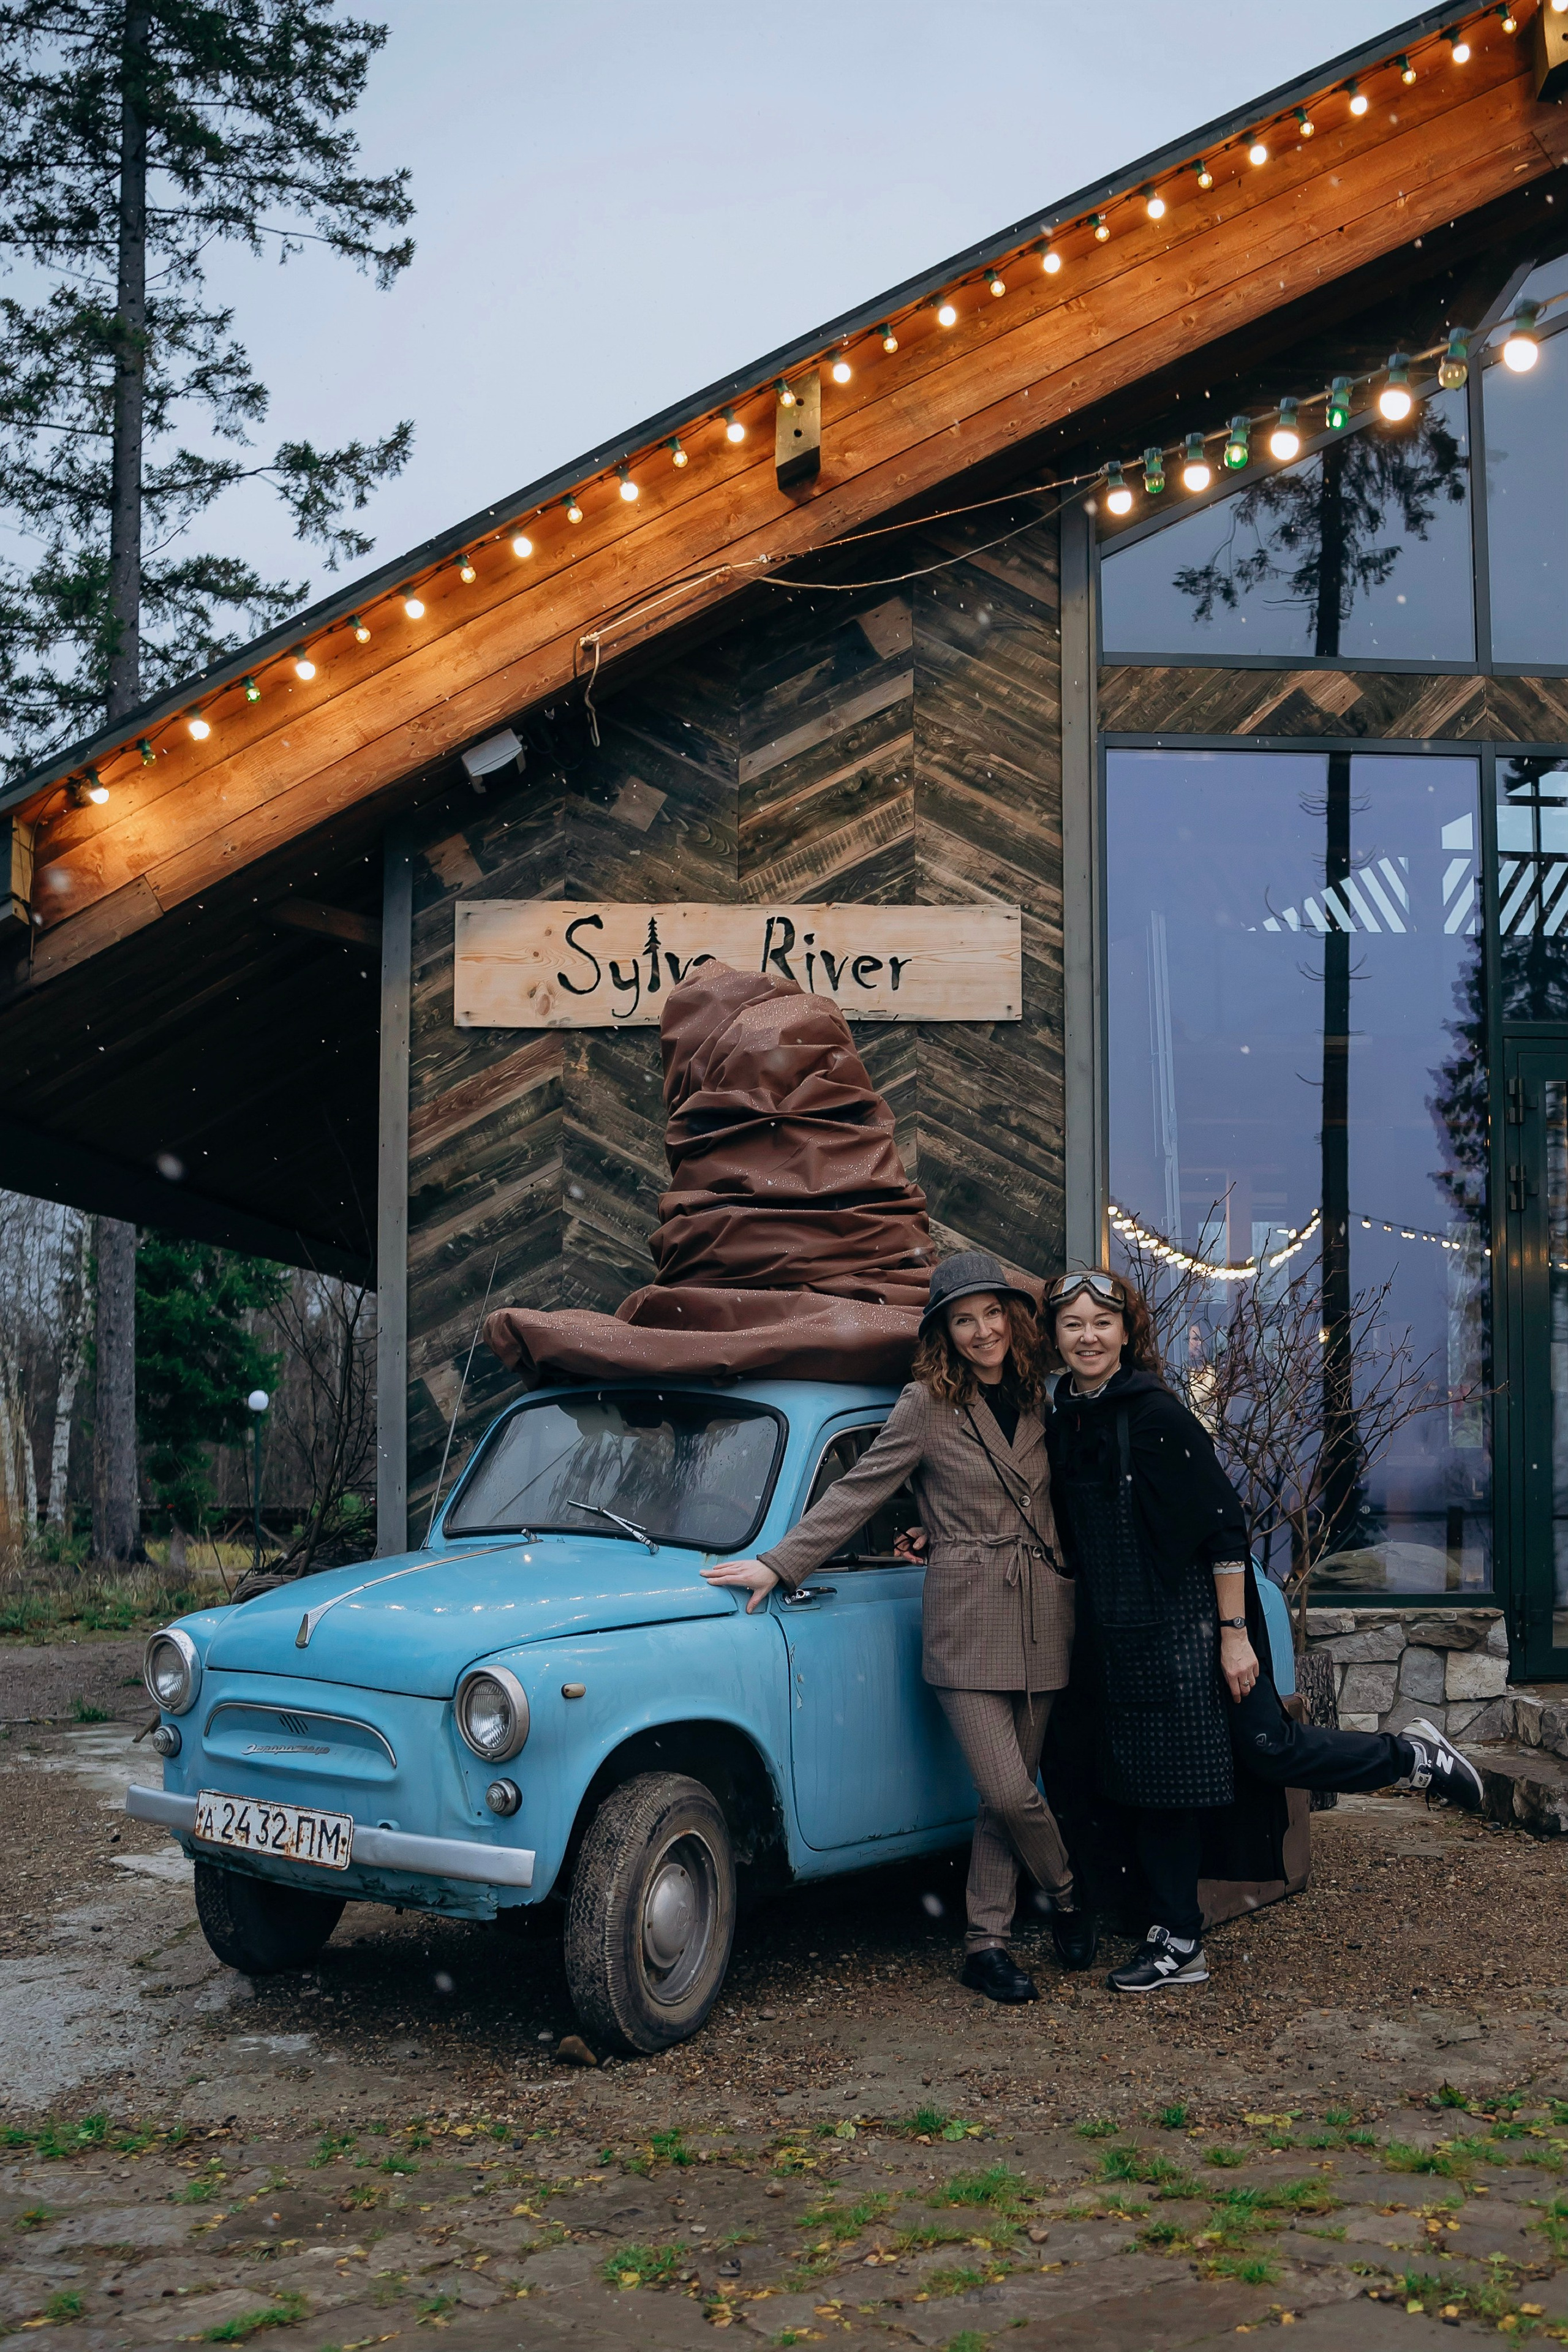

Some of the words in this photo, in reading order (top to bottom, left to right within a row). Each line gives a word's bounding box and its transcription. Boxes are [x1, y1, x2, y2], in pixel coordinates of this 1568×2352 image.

[557, 914, 717, 1019] Sylv
[761, 916, 913, 993] River
[1436, 1748, 1454, 1775] N
[1153, 1954, 1179, 1976] N
